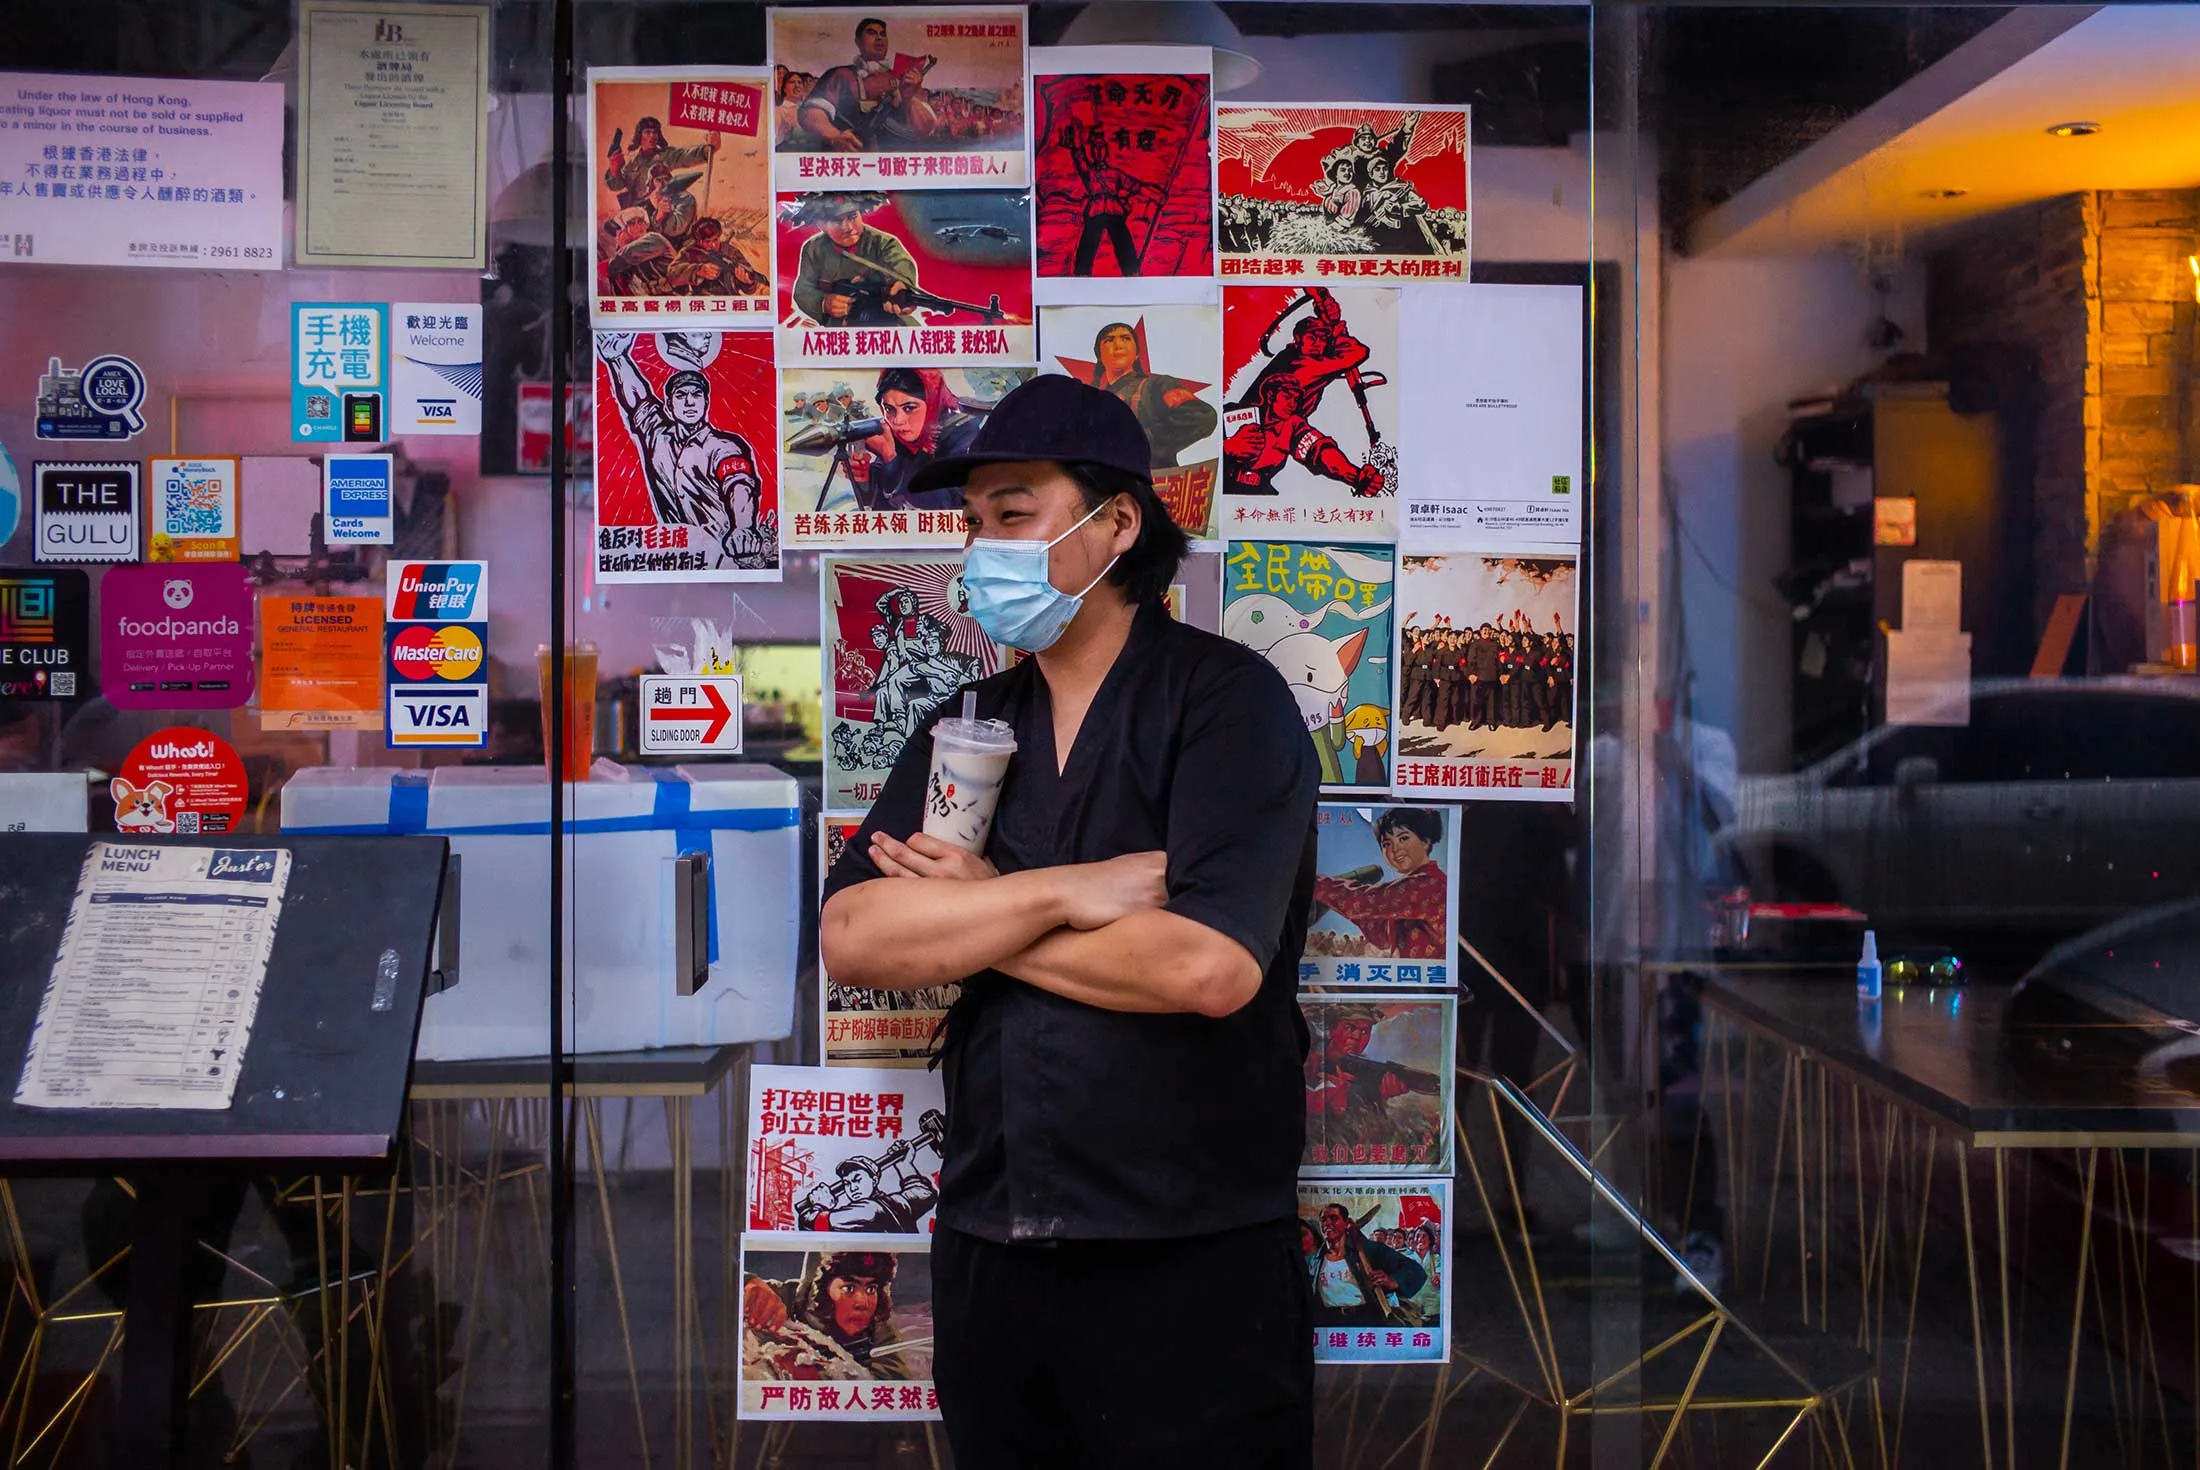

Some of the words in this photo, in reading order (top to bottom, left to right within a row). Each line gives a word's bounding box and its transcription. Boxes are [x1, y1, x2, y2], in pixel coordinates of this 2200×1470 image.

[18, 89, 53, 102] Under
[58, 91, 76, 102] the
[80, 91, 100, 102] law
[106, 92, 119, 103] of
[122, 93, 153, 107] Hong
[39, 105, 71, 118] liquor
[76, 107, 105, 118] must
[109, 108, 129, 118] not
[133, 108, 148, 119] be
[151, 109, 176, 120] sold
[179, 112, 192, 121] or
[195, 110, 243, 123] supplied
[12, 122, 19, 130] a
[23, 118, 56, 130] minor
[61, 119, 72, 130] in
[76, 120, 95, 132] the
[99, 124, 138, 134] course
[142, 122, 155, 134] of
[158, 123, 213, 136] business.
[210, 246, 239, 258] 2961
[243, 247, 273, 259] 8823
[1220, 258, 1305, 275] 团结起来
[1316, 259, 1462, 277] 争取更大的胜利
[305, 314, 371, 346] 手機
[406, 315, 469, 330] 歡迎光臨
[410, 334, 465, 346] Welcome
[802, 330, 850, 356] 人不犯我
[855, 329, 903, 356] 我不犯人
[909, 329, 956, 354] 人若犯我
[305, 348, 371, 380] 充電
[96, 387, 128, 396] LOCAL
[98, 379, 125, 387] LOVE
[422, 405, 452, 417] VISA
[330, 479, 385, 489] AMERICAN
[56, 482, 119, 504] THE
[341, 490, 388, 500] EXPRESS
[1442, 505, 1468, 514] Isaac
[332, 518, 363, 527] Cards
[794, 513, 908, 536] 苦练杀敌本领
[46, 522, 129, 545] GULU
[332, 529, 380, 537] Welcome
[401, 578, 474, 597] UnionPay
[429, 594, 467, 609] 银联
[118, 616, 239, 640] foodpanda
[294, 616, 353, 624] LICENSED
[317, 625, 368, 633] RESTAURANT
[19, 648, 70, 665] CLUB
[394, 645, 480, 661] MasterCard
[123, 663, 159, 673] Delivery
[204, 662, 235, 671] Partner
[654, 687, 697, 705] 趟門
[403, 704, 470, 727] VISA
[651, 729, 679, 742] SLIDING
[680, 729, 701, 742] DOOR
[151, 741, 215, 759] Whoot!
[103, 847, 160, 861] LUNCH
[100, 860, 150, 872] MENU
[1336, 963, 1447, 984] 消灭四害
[762, 1088, 904, 1116] 打碎旧世界
[761, 1111, 904, 1139] 创立新世界
[1312, 1331, 1432, 1348] 继续革命
